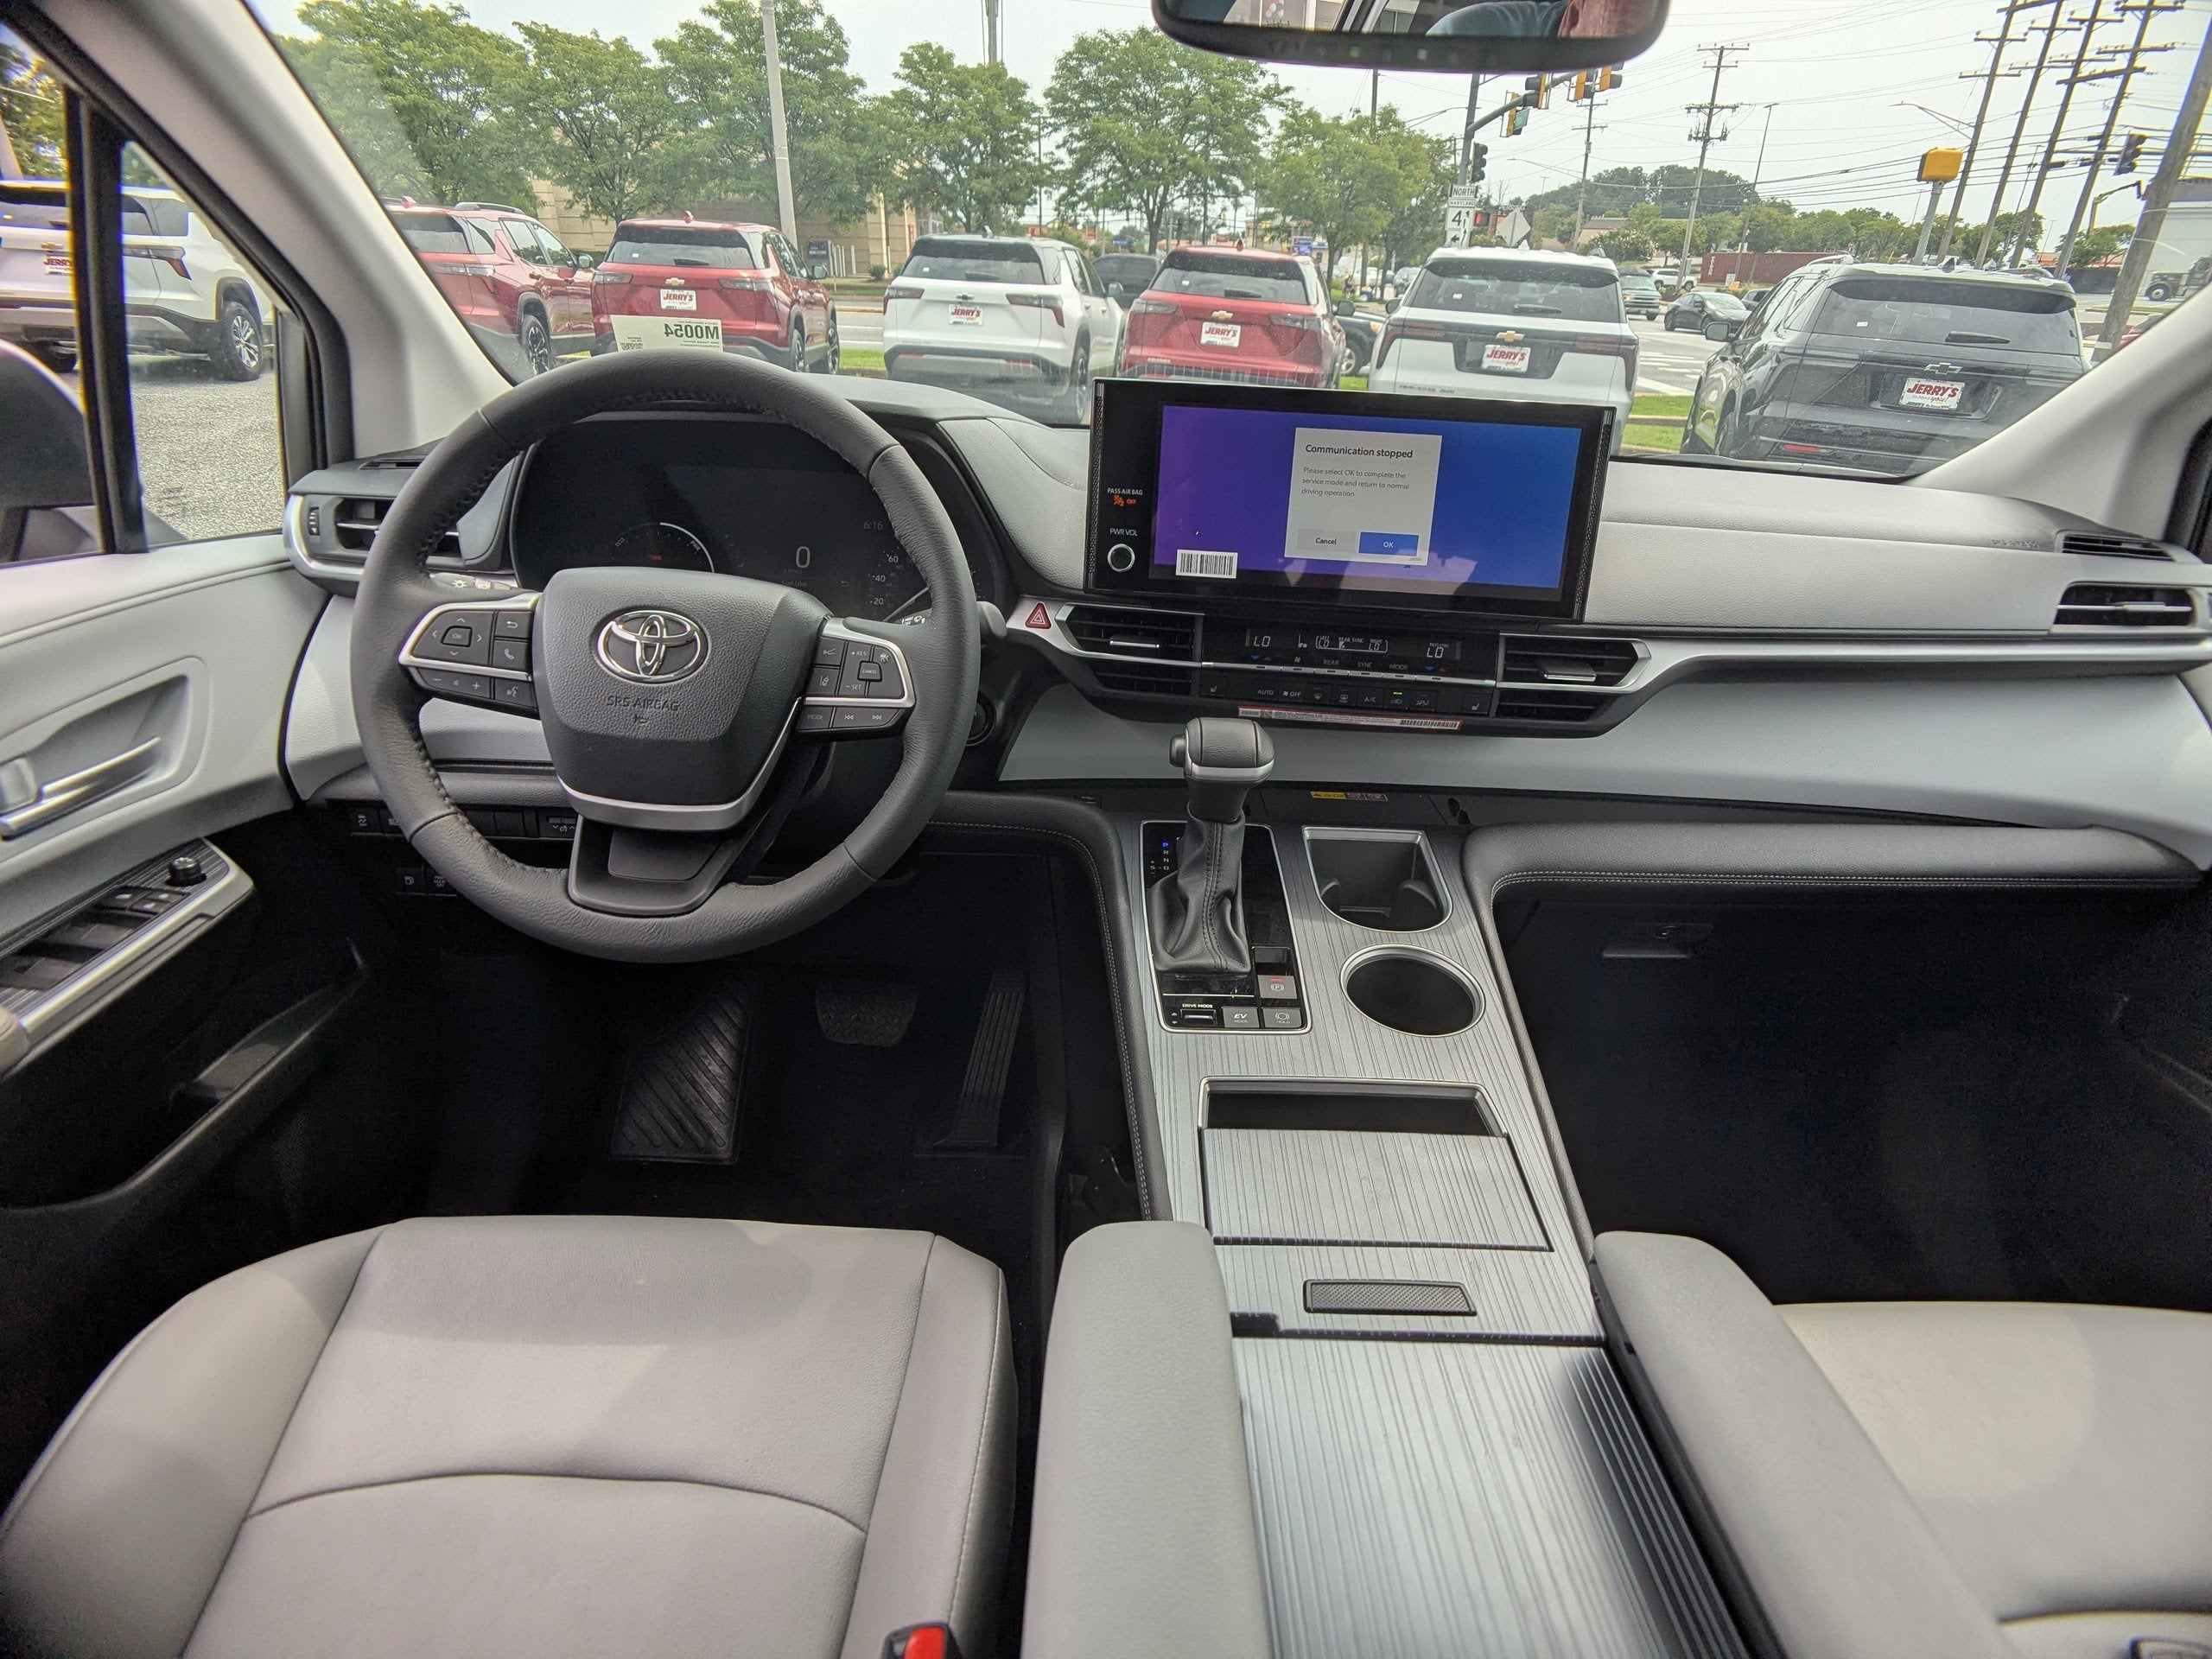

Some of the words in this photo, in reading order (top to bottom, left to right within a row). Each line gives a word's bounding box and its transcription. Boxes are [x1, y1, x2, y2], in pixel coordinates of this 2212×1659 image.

[1452, 187, 1475, 196] NORTH
[663, 292, 694, 302] JERRY'S
[950, 308, 982, 318] JERRY'S
[1205, 326, 1238, 337] JERRY'S
[1485, 348, 1527, 361] JERRY'S
[1907, 384, 1959, 397] JERRY'S
[1305, 444, 1375, 456] Communication
[1376, 448, 1414, 460] stopped
[1300, 487, 1323, 497] driving
[1315, 537, 1338, 545] Cancel
[796, 545, 810, 569] 0
[607, 695, 631, 707] SRS
[633, 698, 680, 711] AIRBAG
